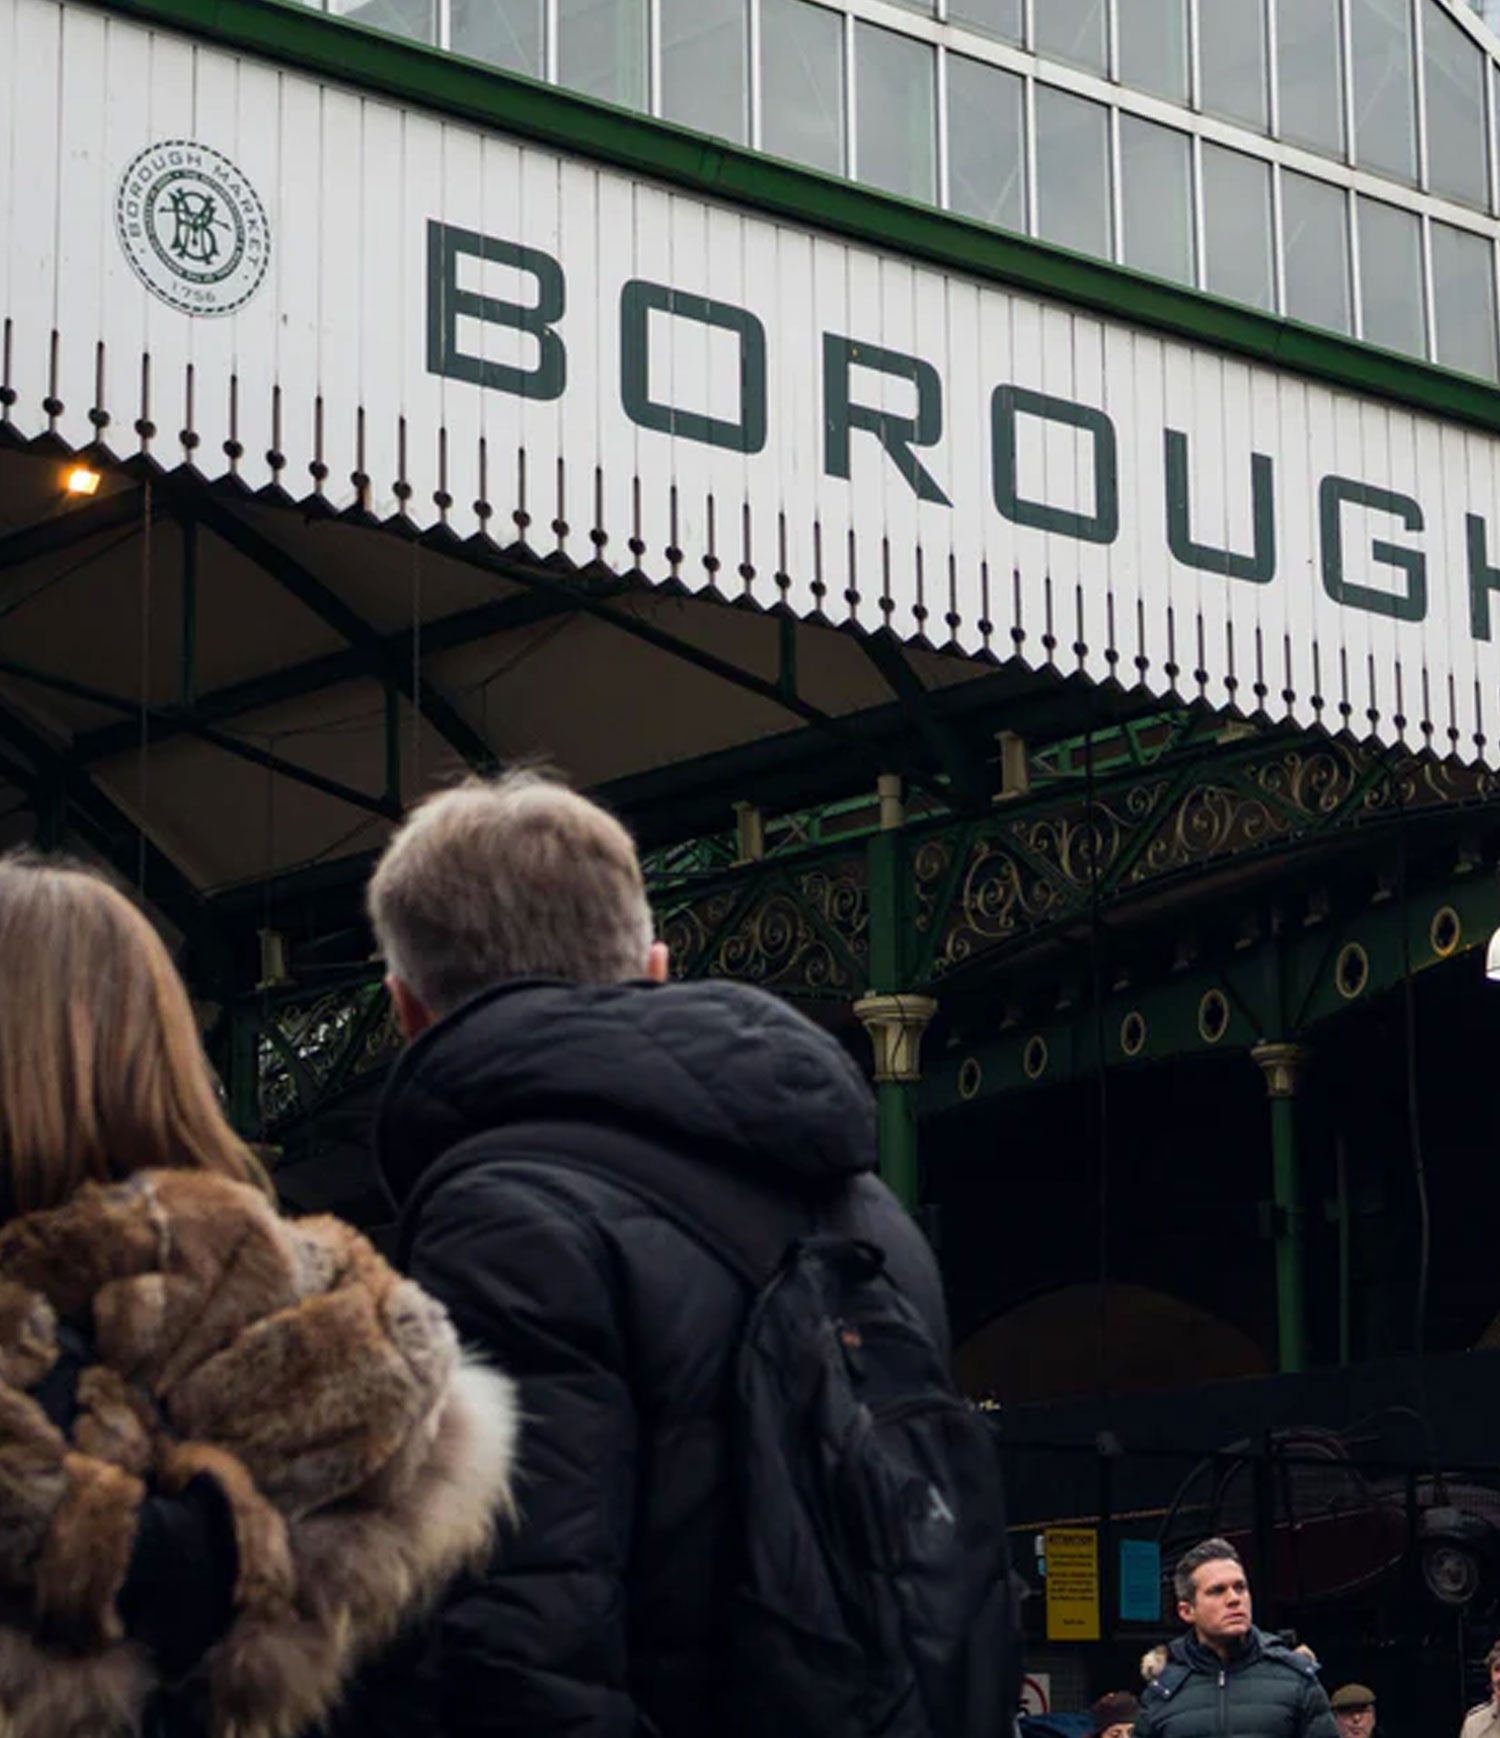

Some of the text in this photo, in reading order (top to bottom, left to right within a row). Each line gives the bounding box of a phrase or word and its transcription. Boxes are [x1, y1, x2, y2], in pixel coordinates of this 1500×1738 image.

[127, 151, 202, 238] BOROUGH
[213, 165, 261, 267] MARKET
[172, 281, 216, 302] 1756
